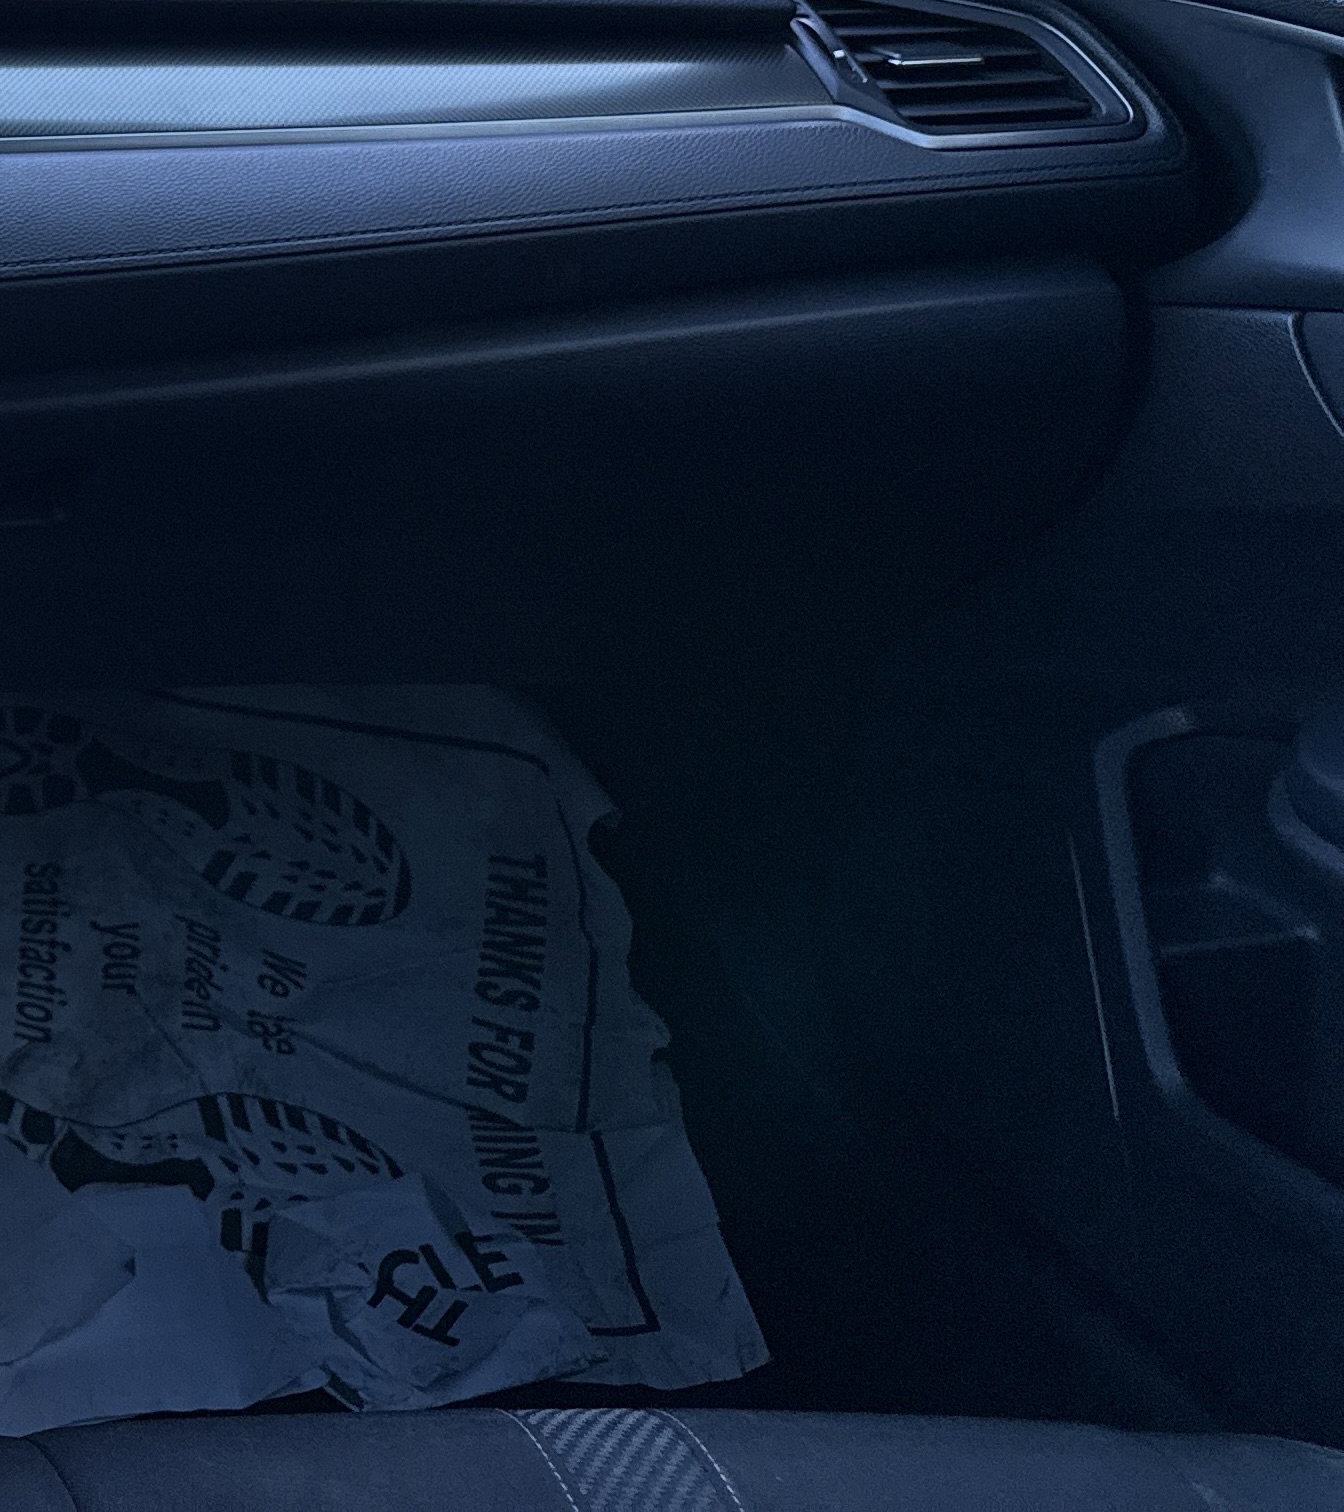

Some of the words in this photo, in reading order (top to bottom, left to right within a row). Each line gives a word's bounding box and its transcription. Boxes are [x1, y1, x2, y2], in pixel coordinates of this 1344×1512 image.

[13, 861, 72, 1043] satisfaction
[88, 919, 141, 997] your
[257, 947, 309, 999] We
[473, 852, 551, 1014] THANKS
[466, 1014, 537, 1106] FOR
